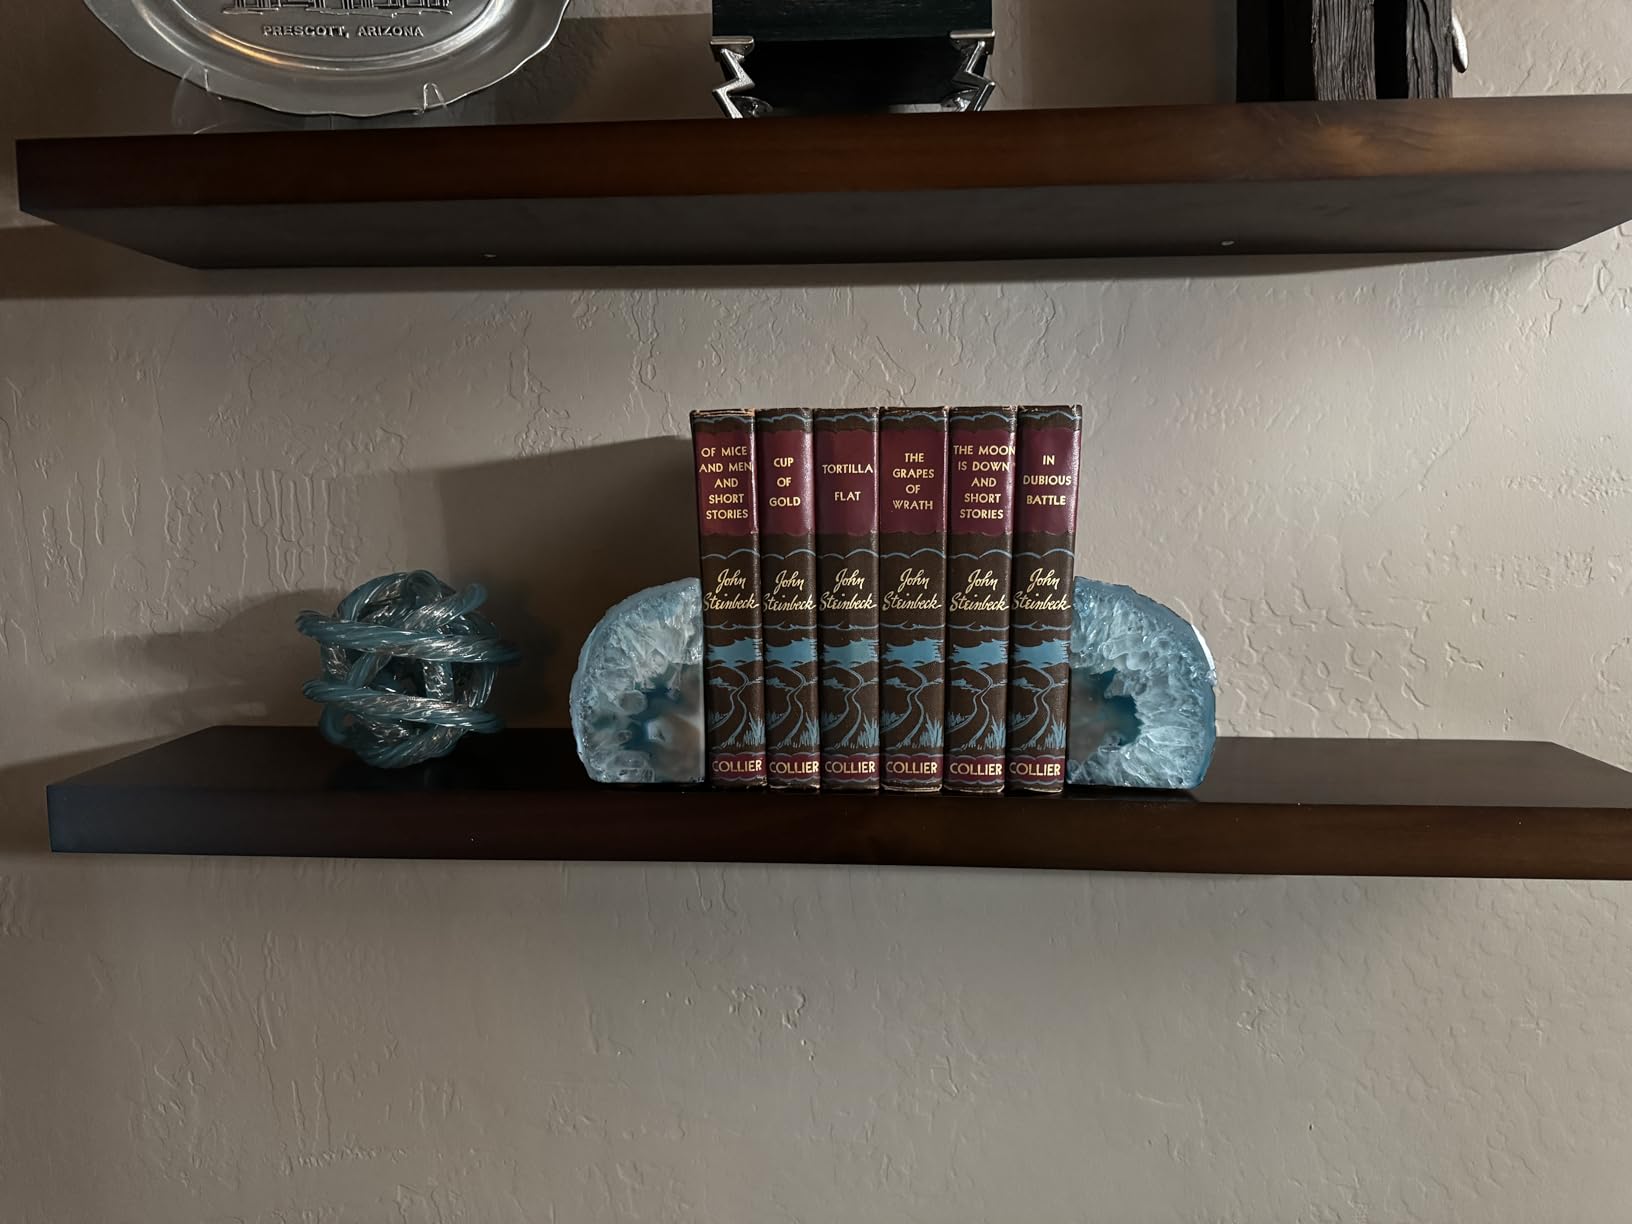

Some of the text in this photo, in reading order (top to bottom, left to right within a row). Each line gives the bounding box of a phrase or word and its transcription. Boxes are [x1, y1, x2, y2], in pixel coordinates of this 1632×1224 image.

[263, 25, 424, 38] PRESCOTT, ARIZONA
[701, 446, 748, 457] OF MICE
[953, 445, 1016, 455] THE MOON
[773, 457, 794, 467] CUP
[904, 452, 925, 463] THE
[1042, 454, 1056, 465] IN
[699, 462, 753, 473] AND MEN
[822, 464, 874, 474] TORTILLA
[957, 461, 1010, 471] IS DOWN
[892, 468, 935, 478] GRAPES
[714, 478, 739, 488] AND
[776, 477, 792, 487] OF
[971, 477, 997, 487] AND
[1023, 474, 1072, 485] DUBIOUS
[905, 484, 921, 494] OF
[708, 493, 745, 504] SHORT
[834, 491, 862, 501] FLAT
[964, 493, 1002, 503] SHORT
[1026, 495, 1067, 505] BATTLE
[769, 497, 801, 507] GOLD
[892, 500, 934, 510] WRATH
[706, 509, 749, 519] STORIES
[959, 508, 1004, 519] STORIES
[716, 568, 747, 594] John
[773, 569, 804, 595] John
[833, 568, 865, 592] John
[898, 568, 930, 593] John
[966, 569, 998, 594] John
[1027, 568, 1060, 593] John
[703, 592, 760, 611] Steinbeck
[763, 592, 817, 612] Steinbeck
[819, 591, 877, 611] Steinbeck
[882, 591, 942, 611] Steinbeck
[950, 592, 1010, 611] Steinbeck
[1012, 591, 1071, 611] Steinbeck
[712, 759, 762, 772] COLLIER
[769, 761, 820, 774] COLLIER
[825, 760, 876, 773] COLLIER
[886, 761, 938, 774] COLLIER
[950, 762, 1003, 775] COLLIER
[1009, 762, 1061, 776] COLLIER
